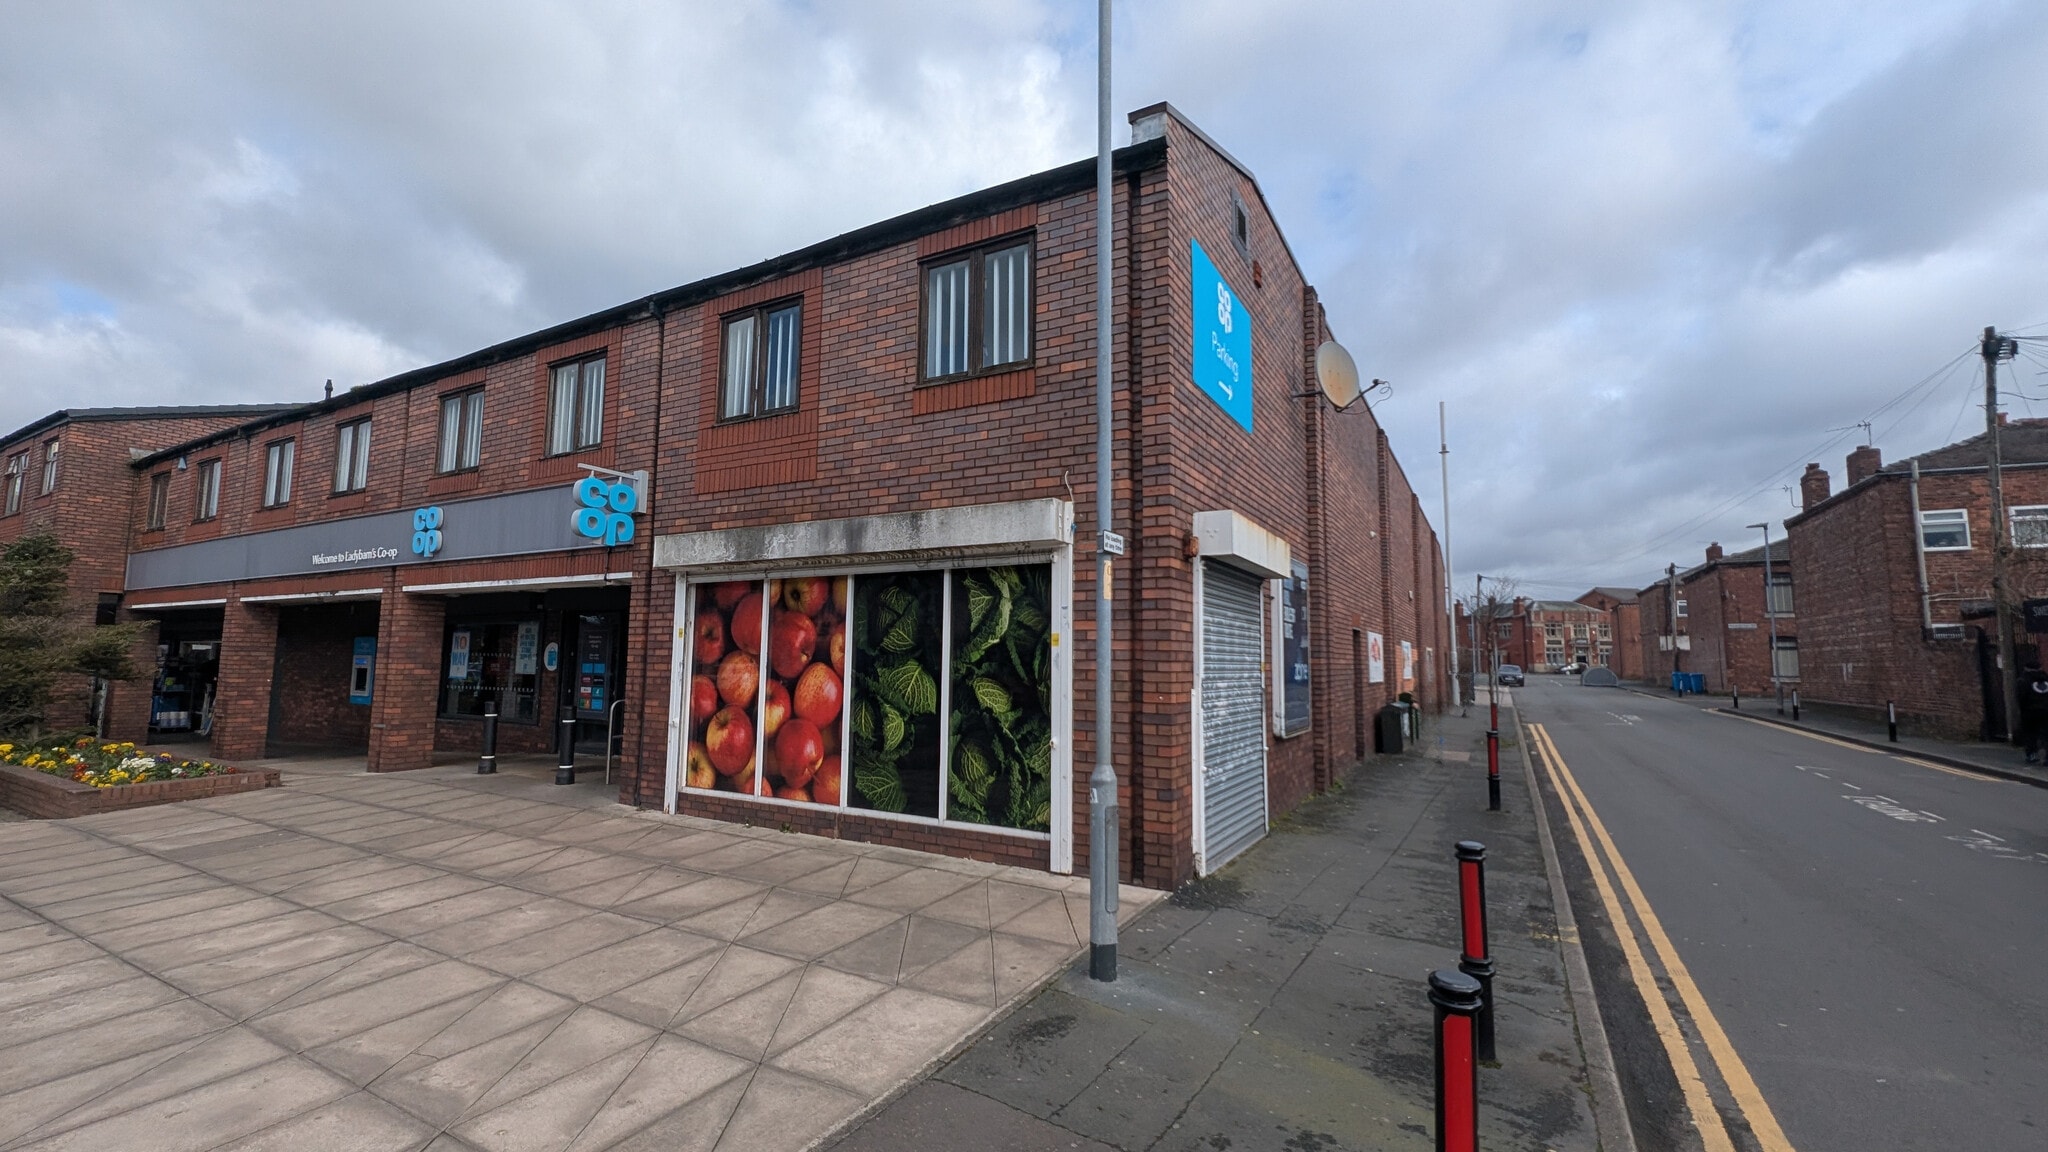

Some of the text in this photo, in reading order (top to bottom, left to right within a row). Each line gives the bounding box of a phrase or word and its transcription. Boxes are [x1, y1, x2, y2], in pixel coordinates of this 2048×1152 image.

[1211, 331, 1239, 383] Parking
[312, 553, 338, 565] Welcome
[338, 553, 345, 563] to
[377, 546, 398, 560] Co-op
[451, 651, 467, 666] WAY
